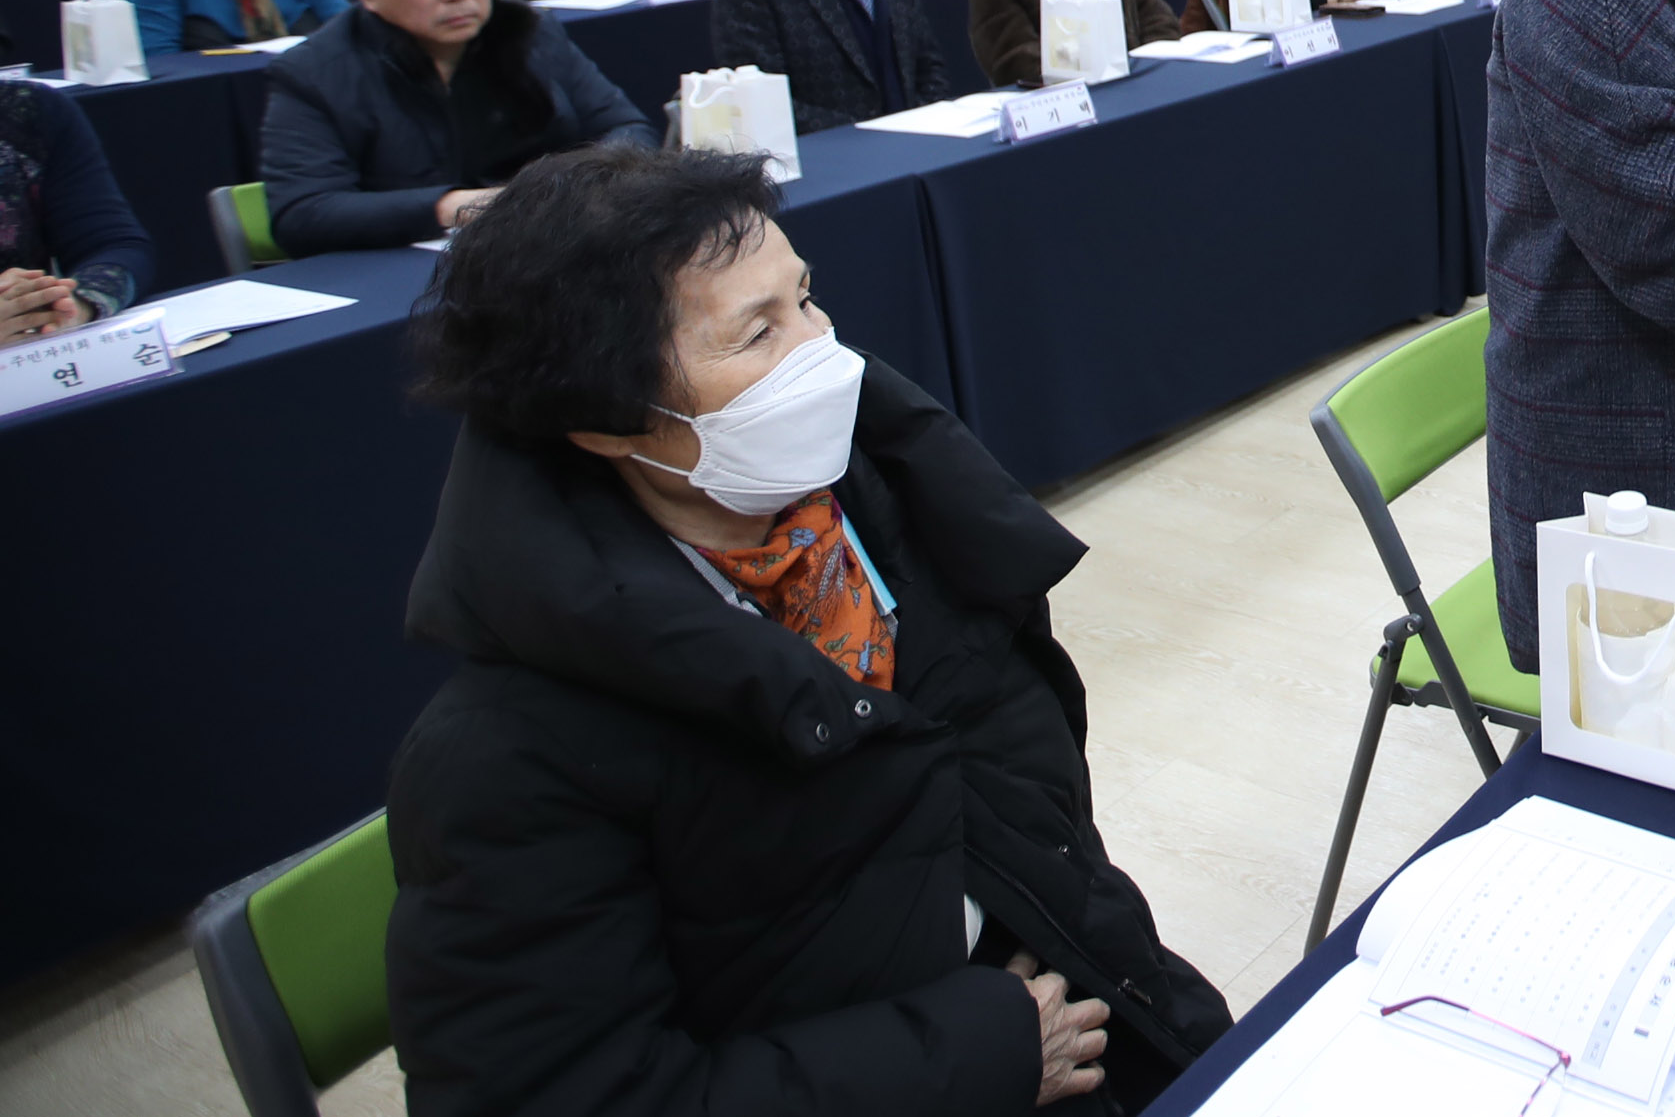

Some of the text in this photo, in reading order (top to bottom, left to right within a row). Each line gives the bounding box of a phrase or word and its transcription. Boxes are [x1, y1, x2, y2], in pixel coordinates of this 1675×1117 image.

[9, 337, 91, 368] 주민자치회
[52, 343, 163, 388] 연 순
